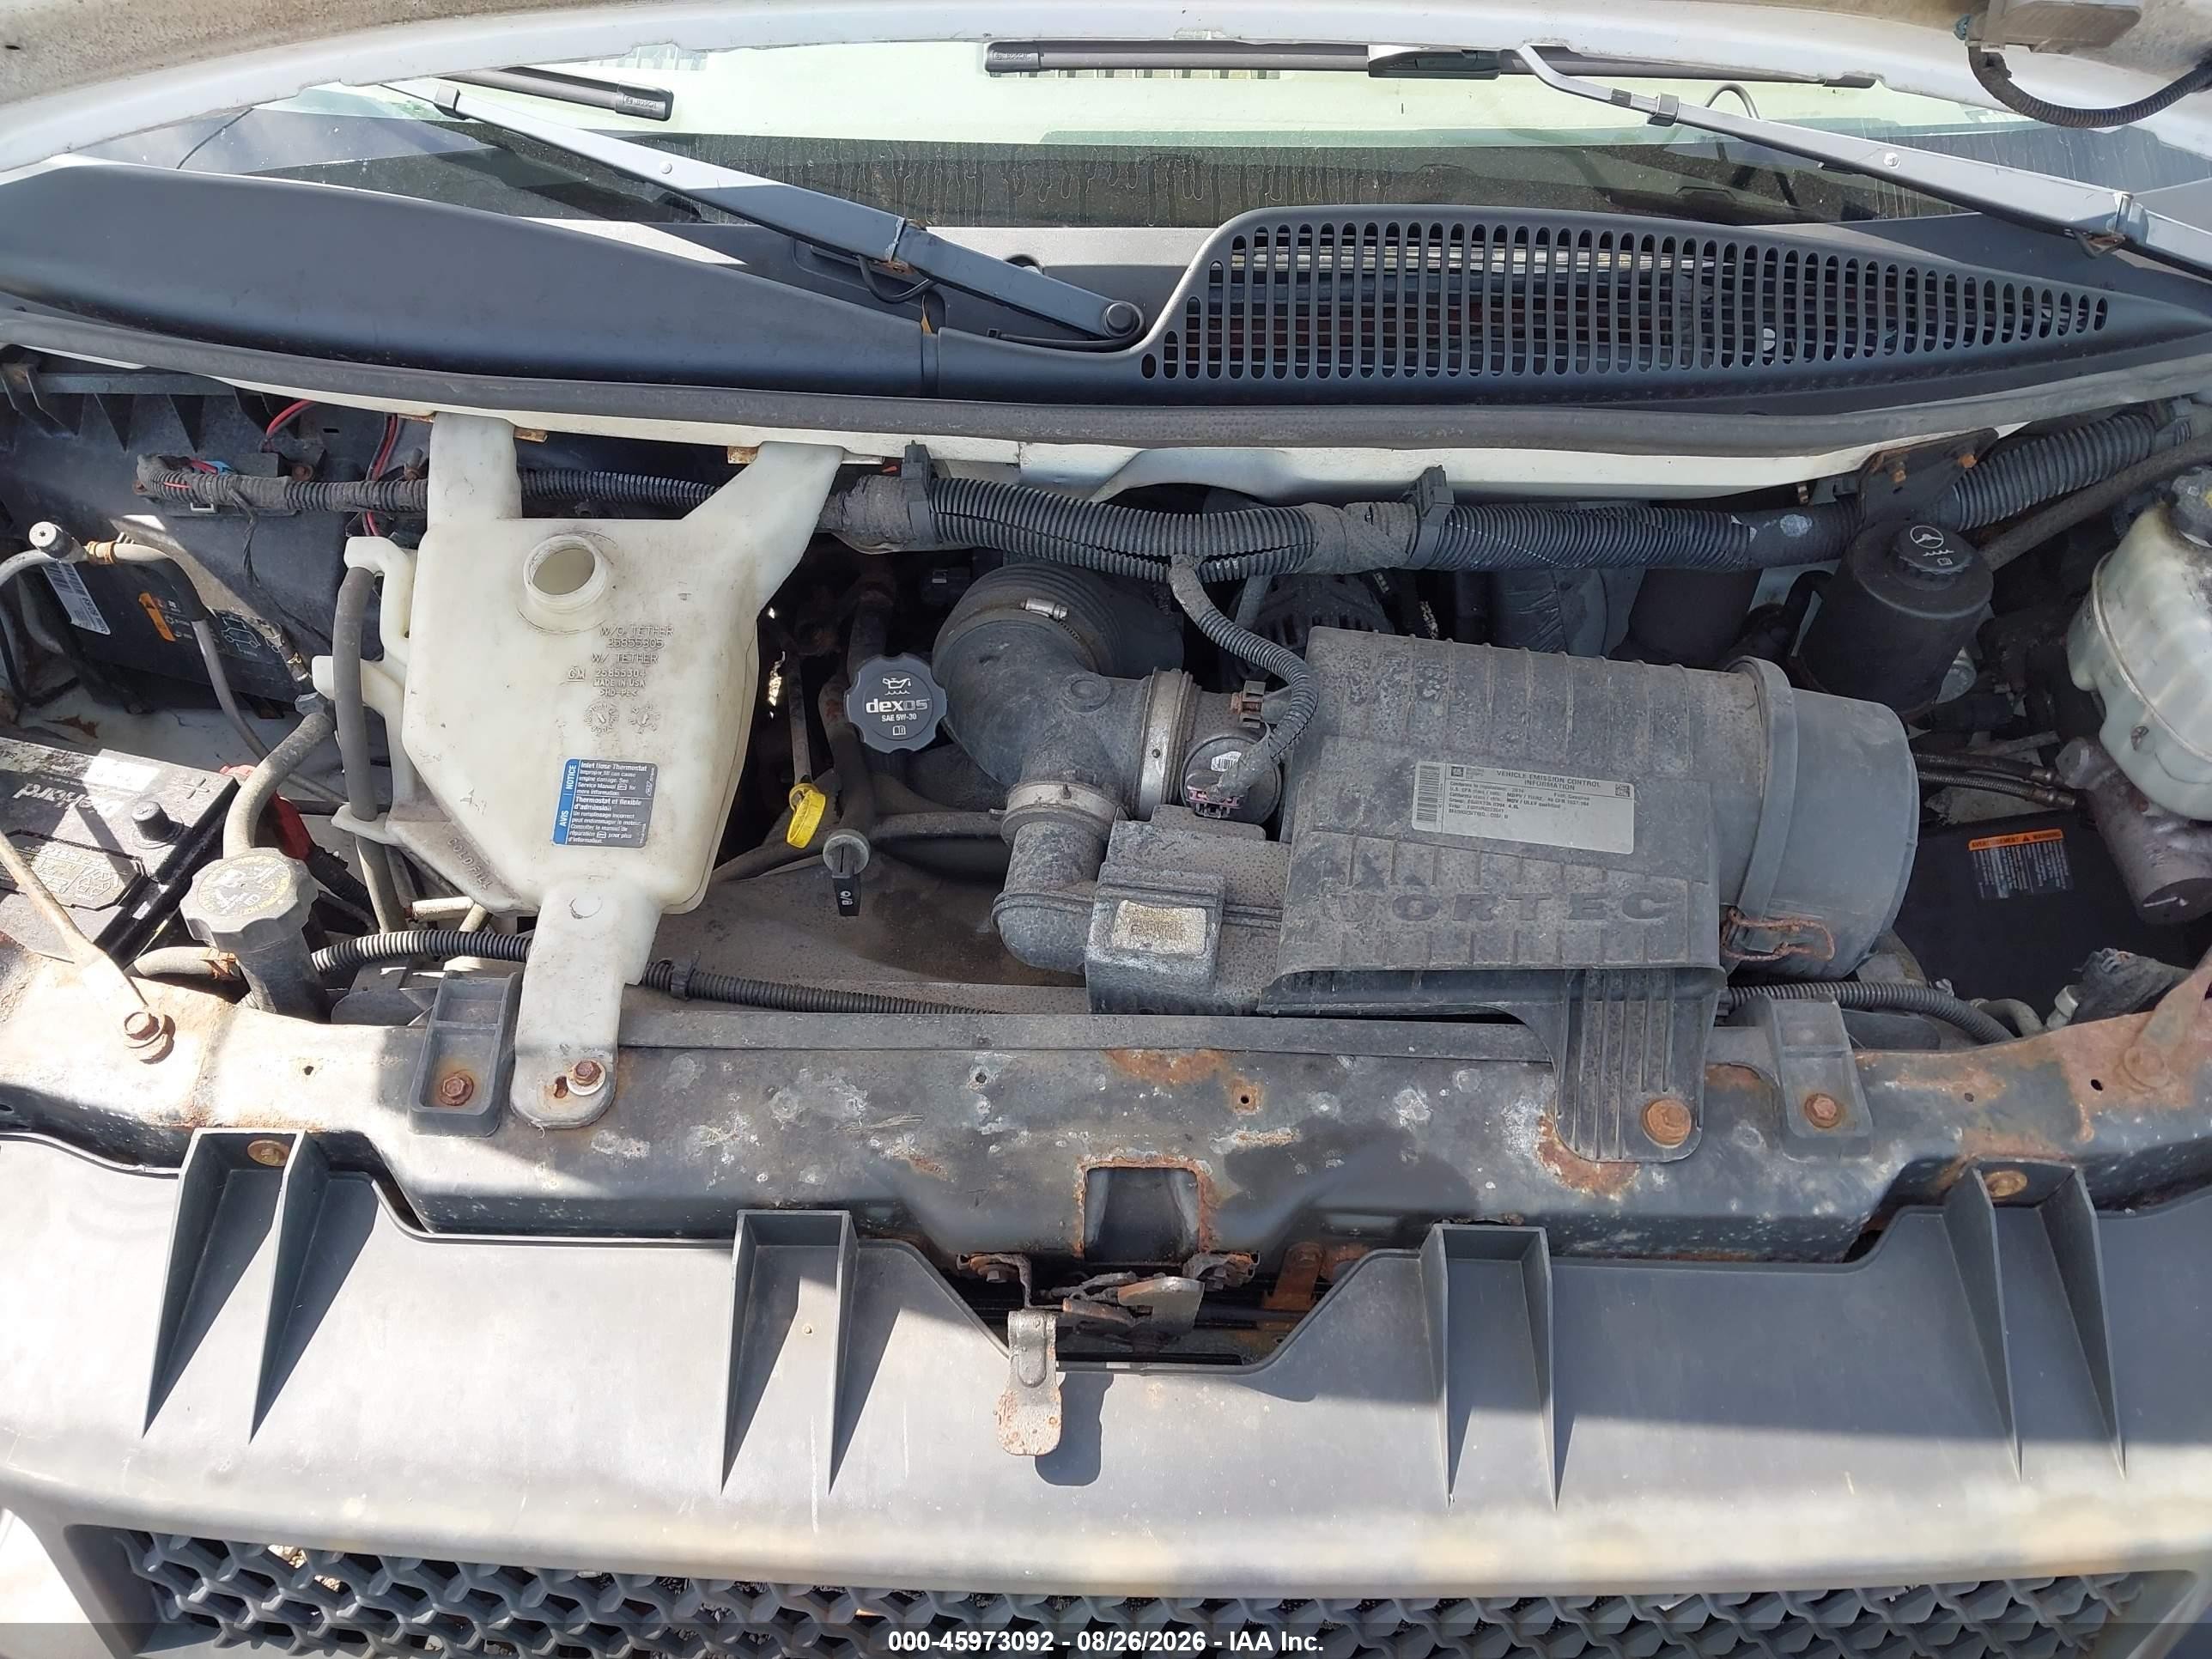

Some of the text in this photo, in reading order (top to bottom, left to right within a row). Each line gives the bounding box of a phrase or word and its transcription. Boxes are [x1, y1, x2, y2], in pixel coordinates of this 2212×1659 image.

[632, 625, 674, 637] TETHER
[591, 653, 659, 664] W/ TETHER
[568, 666, 586, 680] GM
[866, 698, 928, 714] dexos
[896, 713, 917, 721] 5W-30
[612, 763, 647, 772] Thermostat
[566, 765, 577, 789] NOTICE
[1497, 770, 1601, 787] VEHICLE EMISSION CONTROL
[1525, 779, 1575, 790] INFORMATION
[560, 810, 569, 827] AVIS
[447, 837, 475, 866] COLD
[467, 866, 494, 890] FILL
